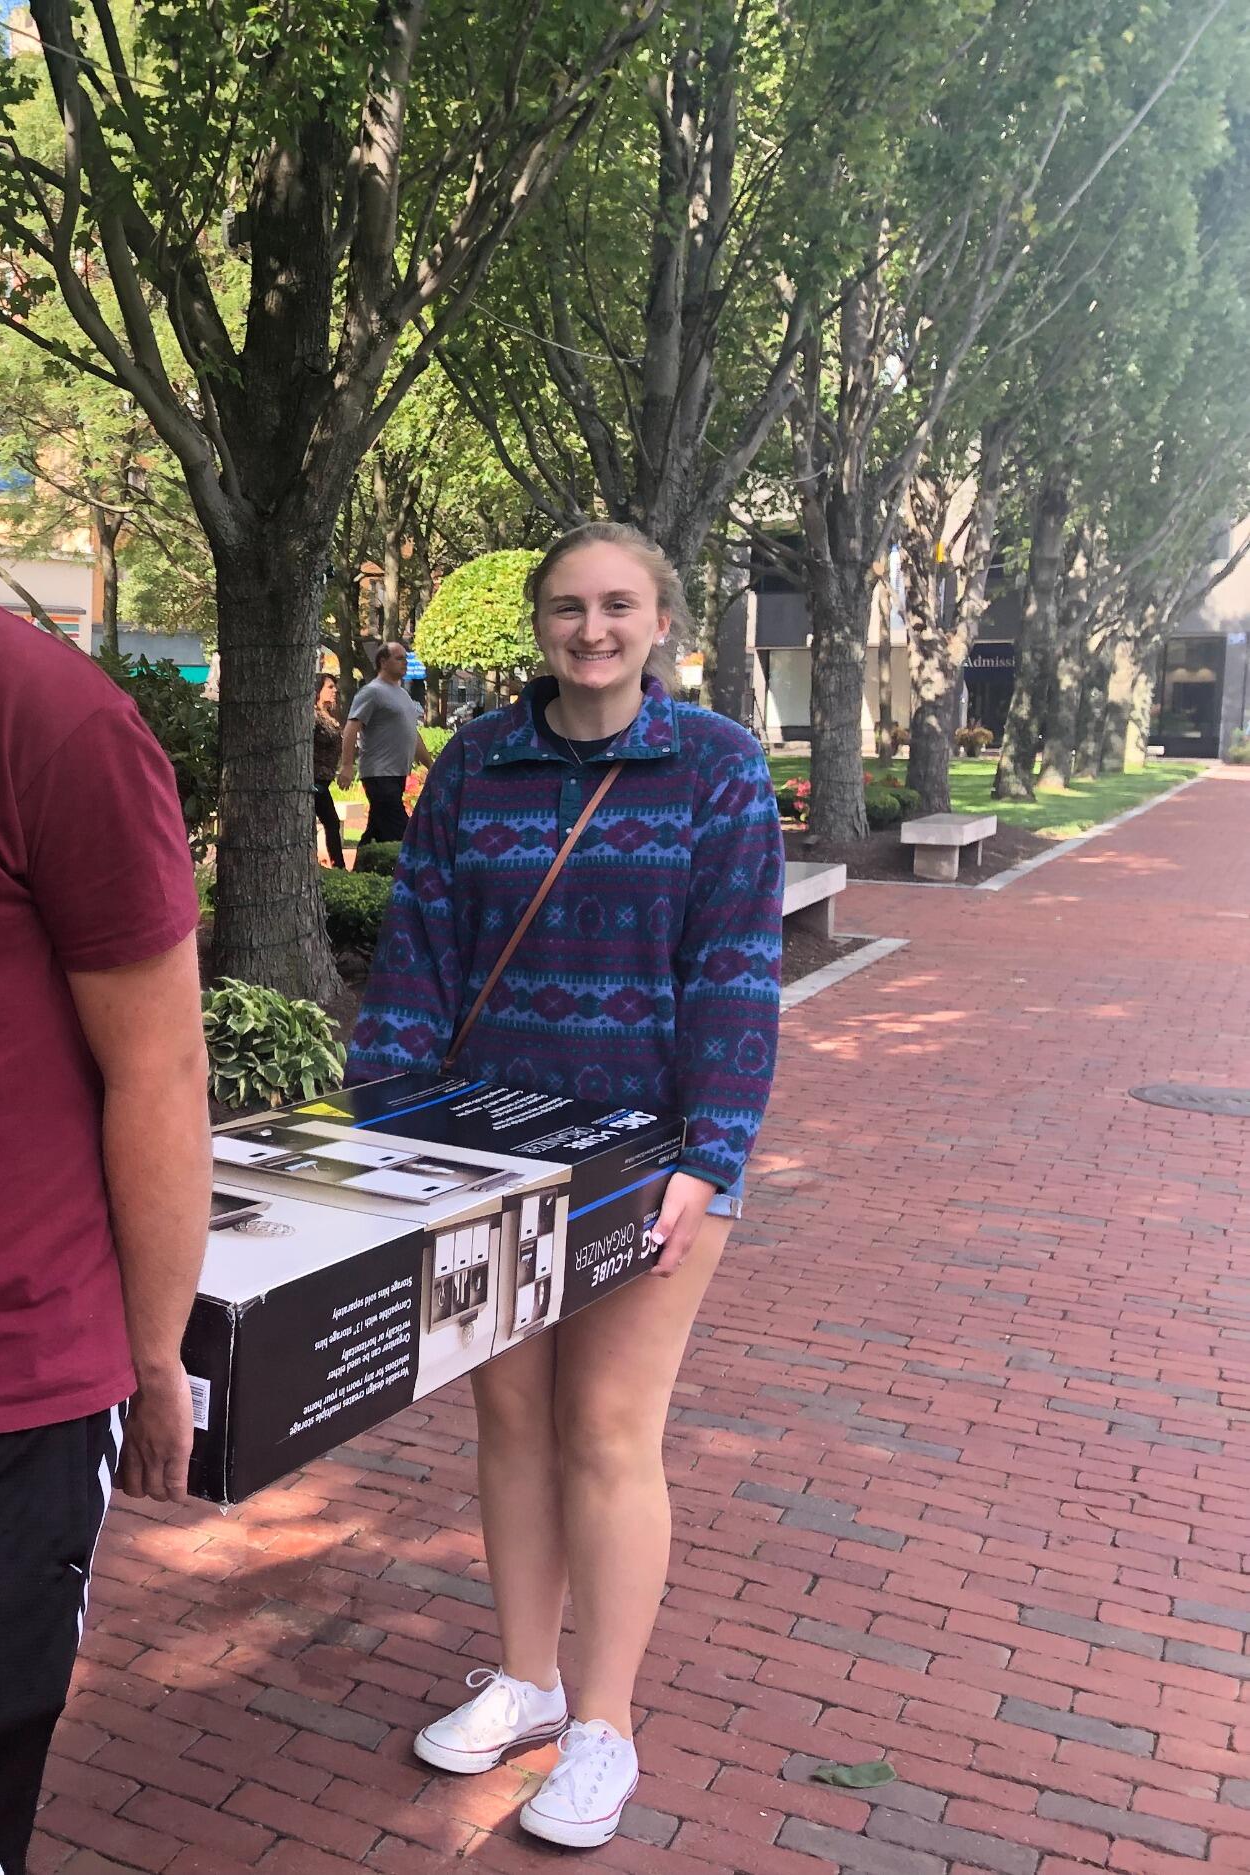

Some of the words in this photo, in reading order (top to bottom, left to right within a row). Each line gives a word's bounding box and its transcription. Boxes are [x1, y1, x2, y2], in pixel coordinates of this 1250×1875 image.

[575, 1222, 635, 1271] ORGANIZER
[591, 1247, 633, 1287] 6-CUBE
[378, 1286, 390, 1299] bins
[390, 1276, 413, 1293] Storage
[365, 1291, 377, 1307] sold
[332, 1297, 364, 1320] separately
[378, 1298, 412, 1321] Compatible
[364, 1316, 378, 1329] with
[385, 1319, 411, 1340] vertically
[329, 1325, 353, 1345] storage
[377, 1331, 385, 1341] or
[382, 1332, 411, 1353] Organizer
[314, 1337, 328, 1351] bins
[341, 1338, 377, 1361] horizontally
[371, 1346, 382, 1358] can
[347, 1357, 362, 1373] used
[362, 1352, 370, 1363] be
[384, 1353, 410, 1373] solutions
[326, 1363, 346, 1381] either
[363, 1371, 375, 1385] any
[374, 1367, 384, 1379] for
[383, 1366, 410, 1386] Versatile
[338, 1387, 346, 1398] in
[345, 1378, 363, 1393] room
[365, 1379, 383, 1396] design
[323, 1387, 339, 1404] your
[342, 1391, 365, 1408] creates
[303, 1397, 323, 1415] home
[315, 1401, 342, 1423] multiple
[289, 1417, 314, 1436] storage
